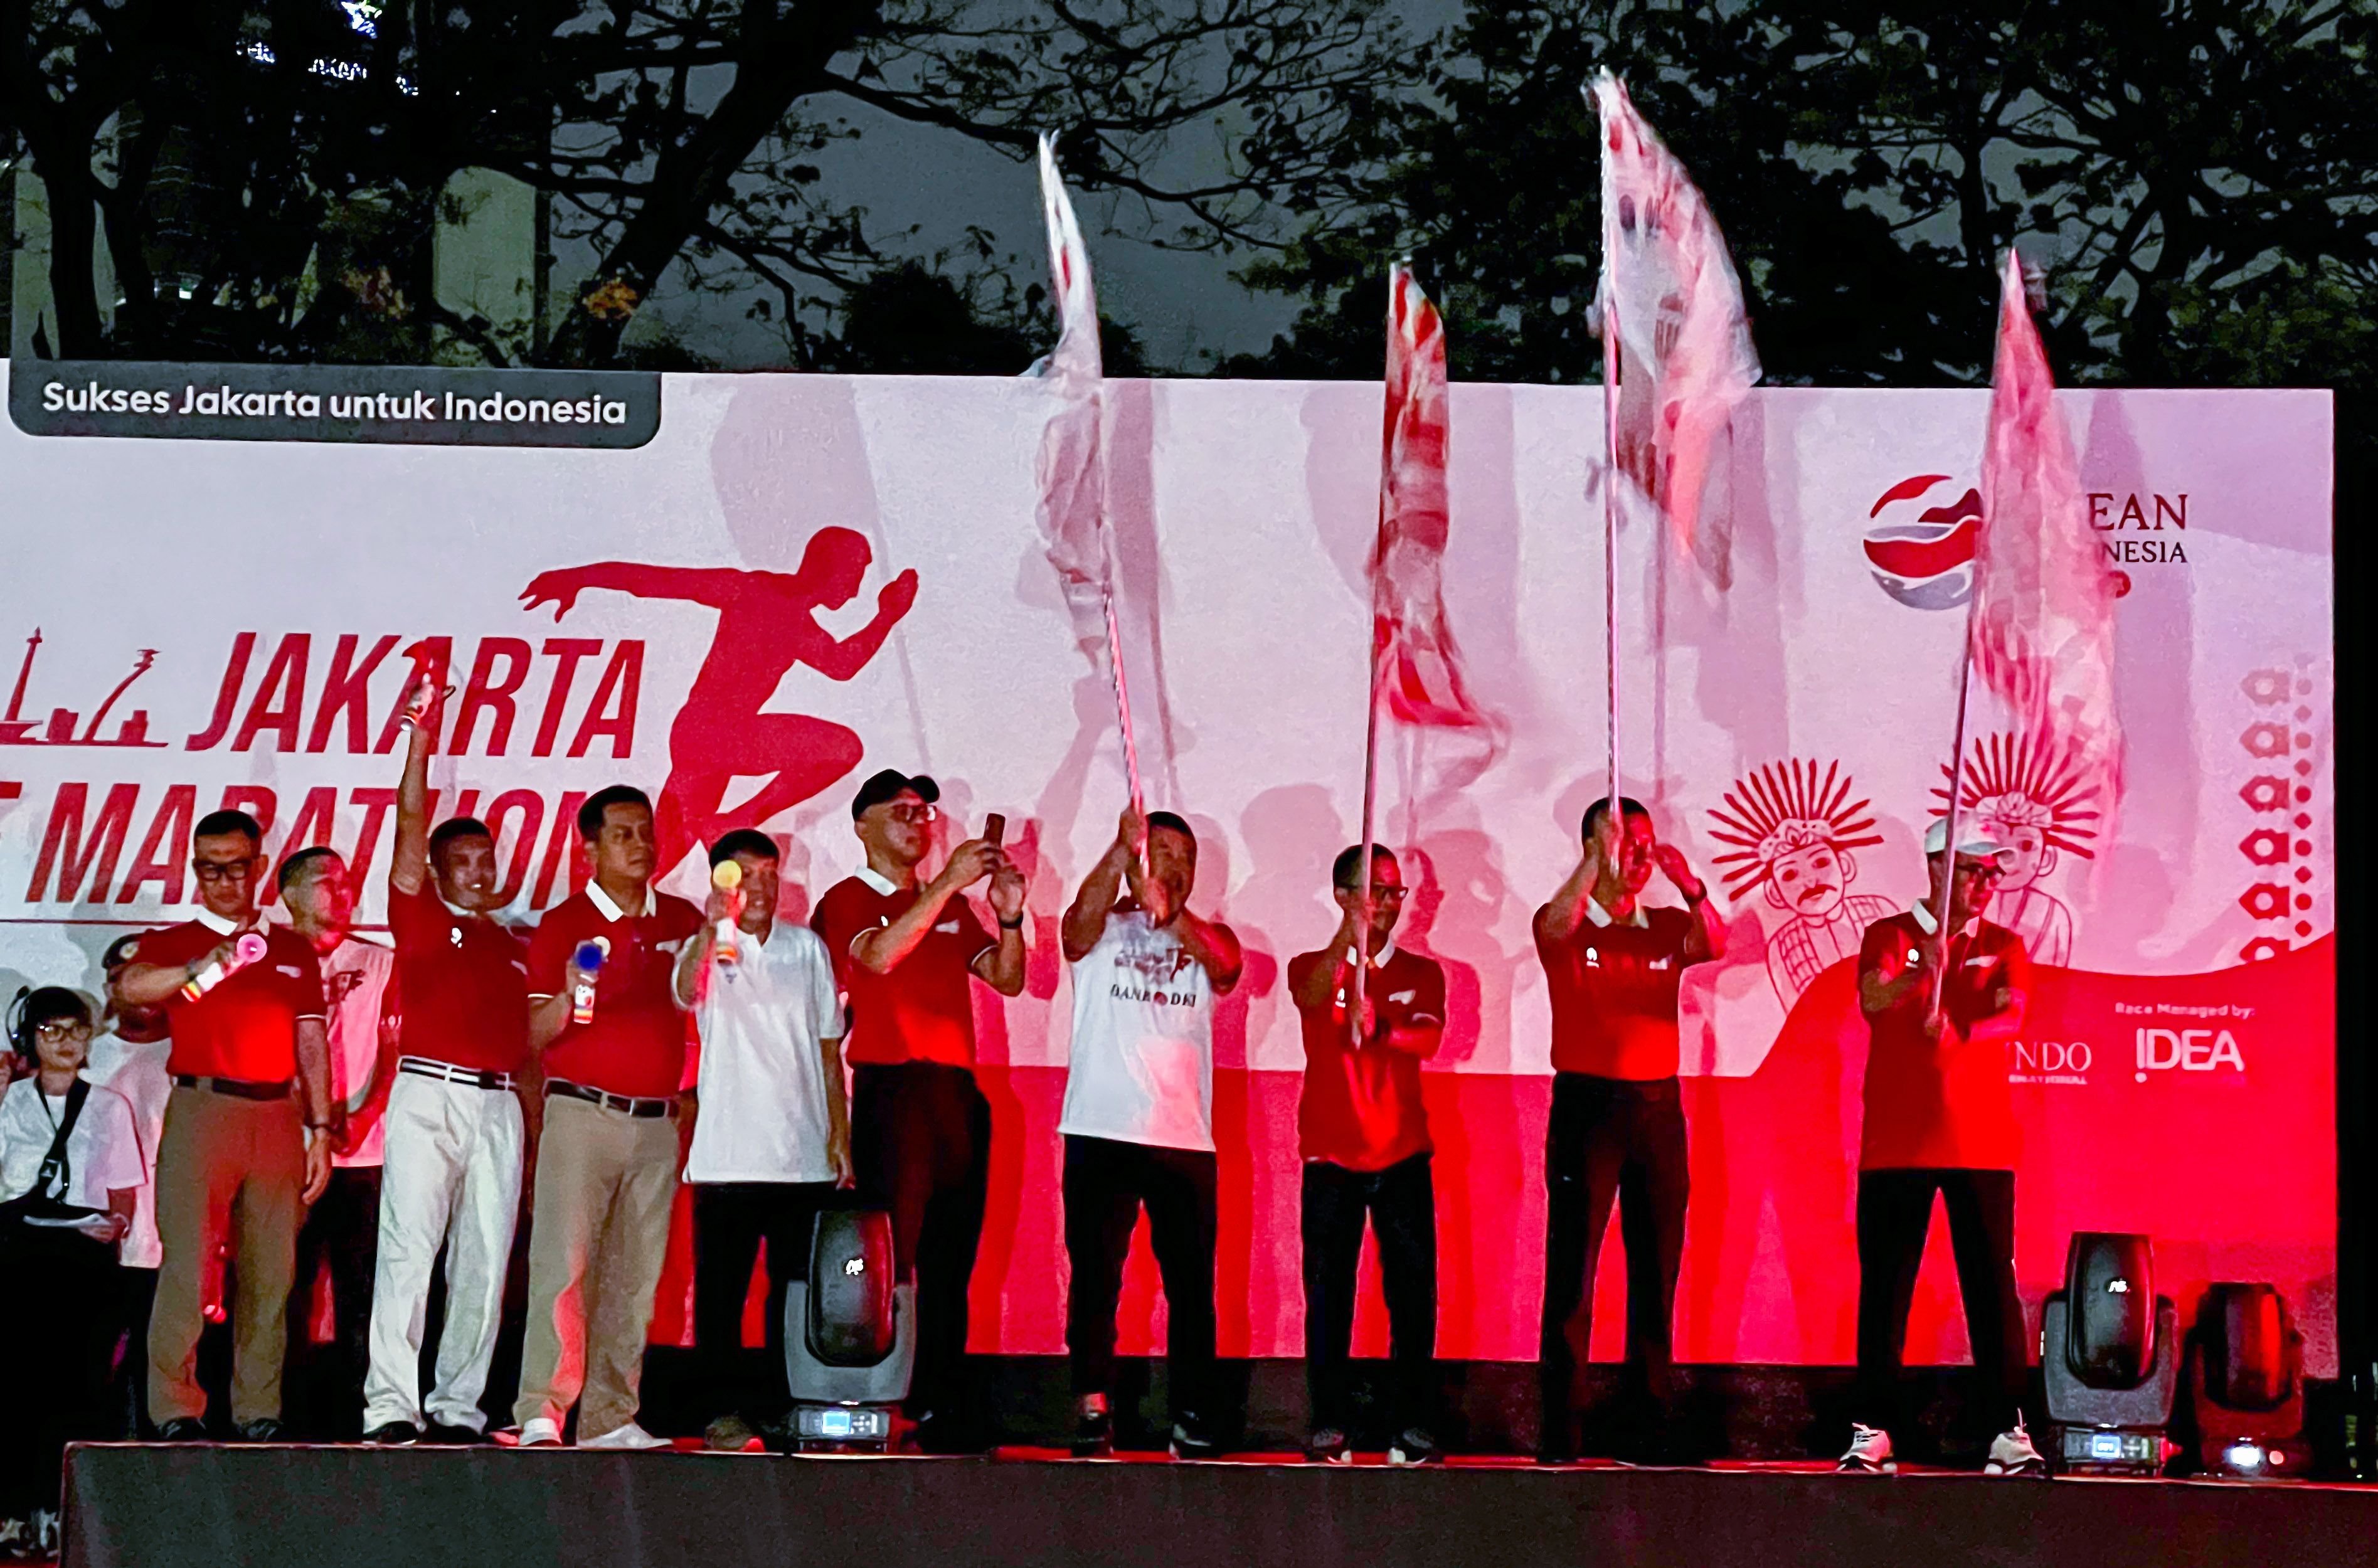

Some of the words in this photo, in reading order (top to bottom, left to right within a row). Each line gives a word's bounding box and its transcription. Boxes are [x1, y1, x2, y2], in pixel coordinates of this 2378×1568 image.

[43, 381, 169, 413] Sukses
[179, 385, 320, 416] Jakarta
[329, 389, 436, 420] untuk
[445, 391, 626, 423] Indonesia
[2088, 493, 2188, 531] EAN
[2103, 541, 2187, 563] NESIA
[185, 632, 645, 759] JAKARTA
[24, 781, 591, 911] MAATON
[2014, 1041, 2092, 1072] NDO
